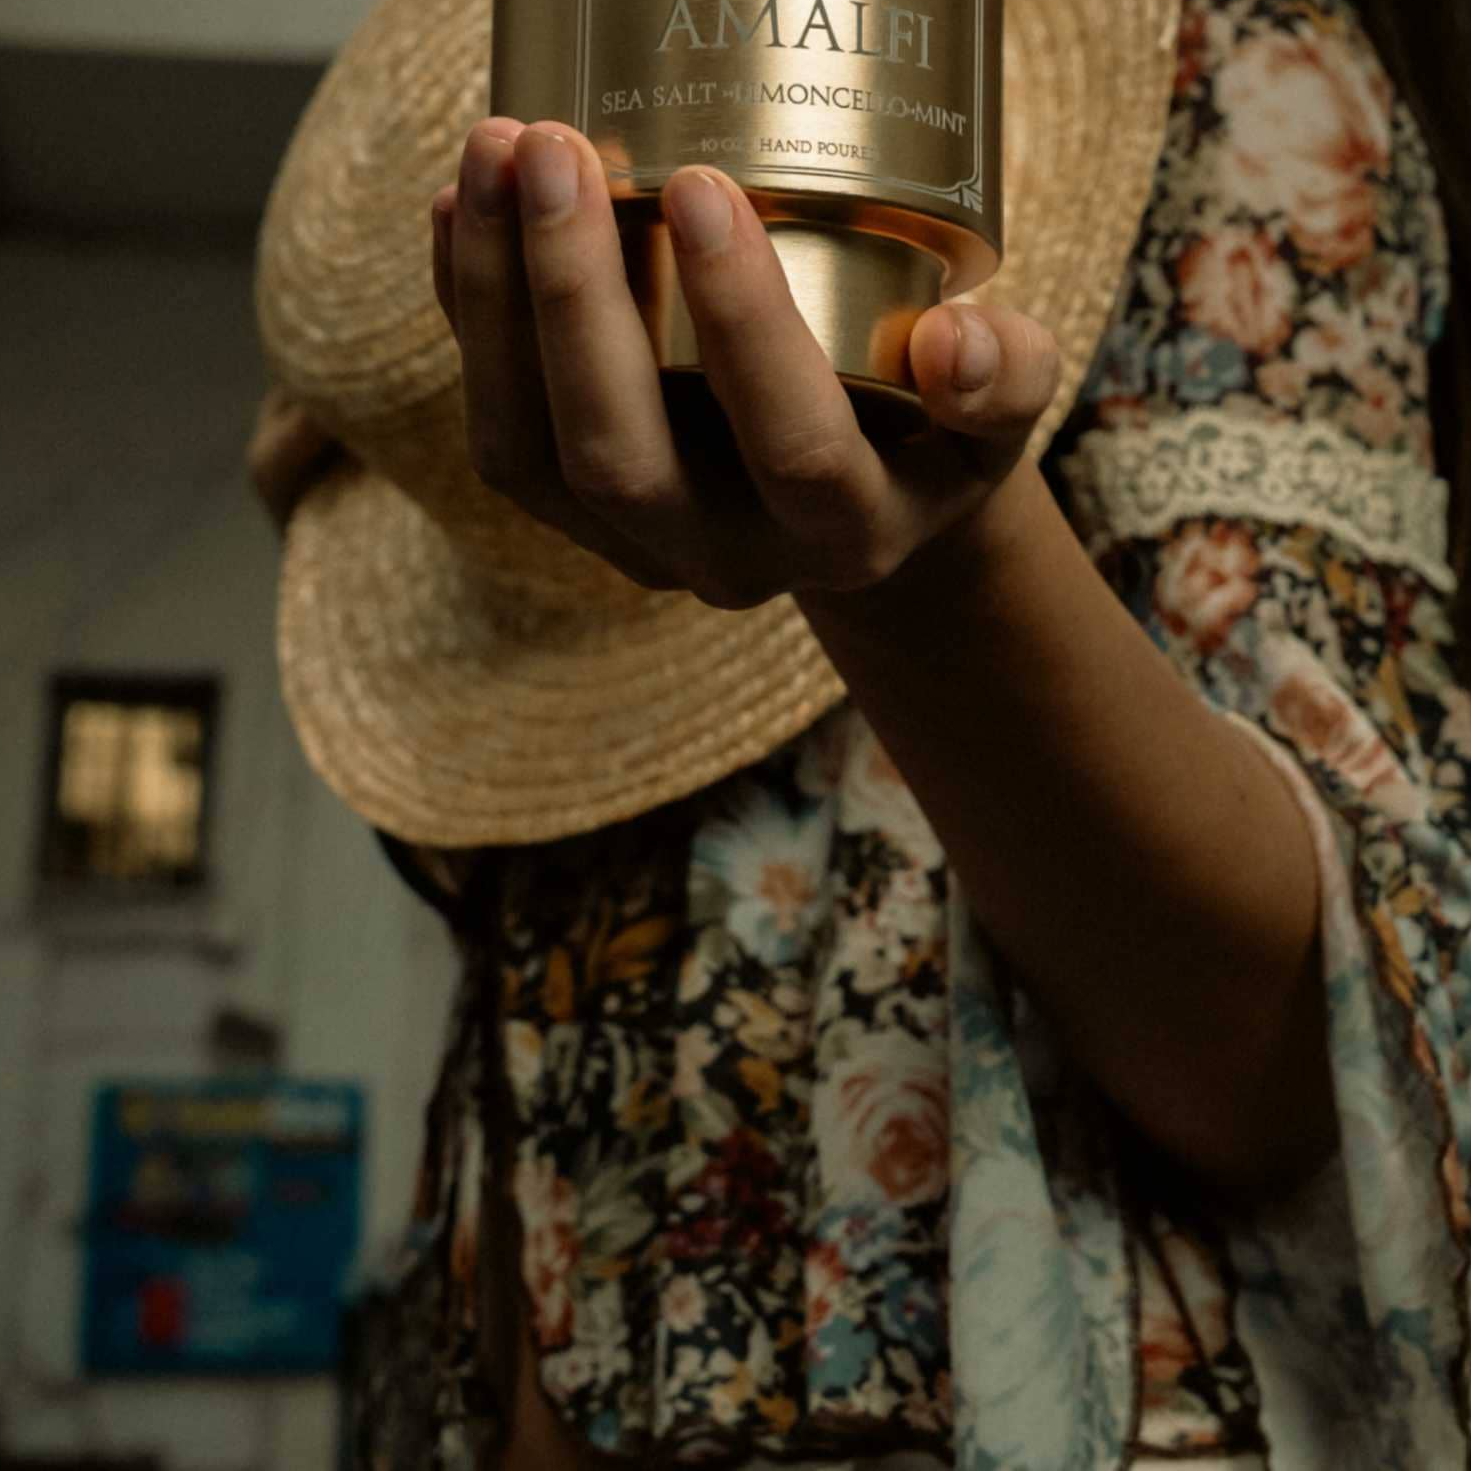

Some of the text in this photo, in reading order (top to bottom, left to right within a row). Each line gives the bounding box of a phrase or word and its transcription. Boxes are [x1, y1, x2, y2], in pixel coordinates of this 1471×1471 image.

[600, 89, 645, 115] SEA
[652, 81, 717, 106] SALT
[913, 100, 968, 137] MINT
[759, 137, 813, 154] HAND
[816, 141, 880, 162] POURE
